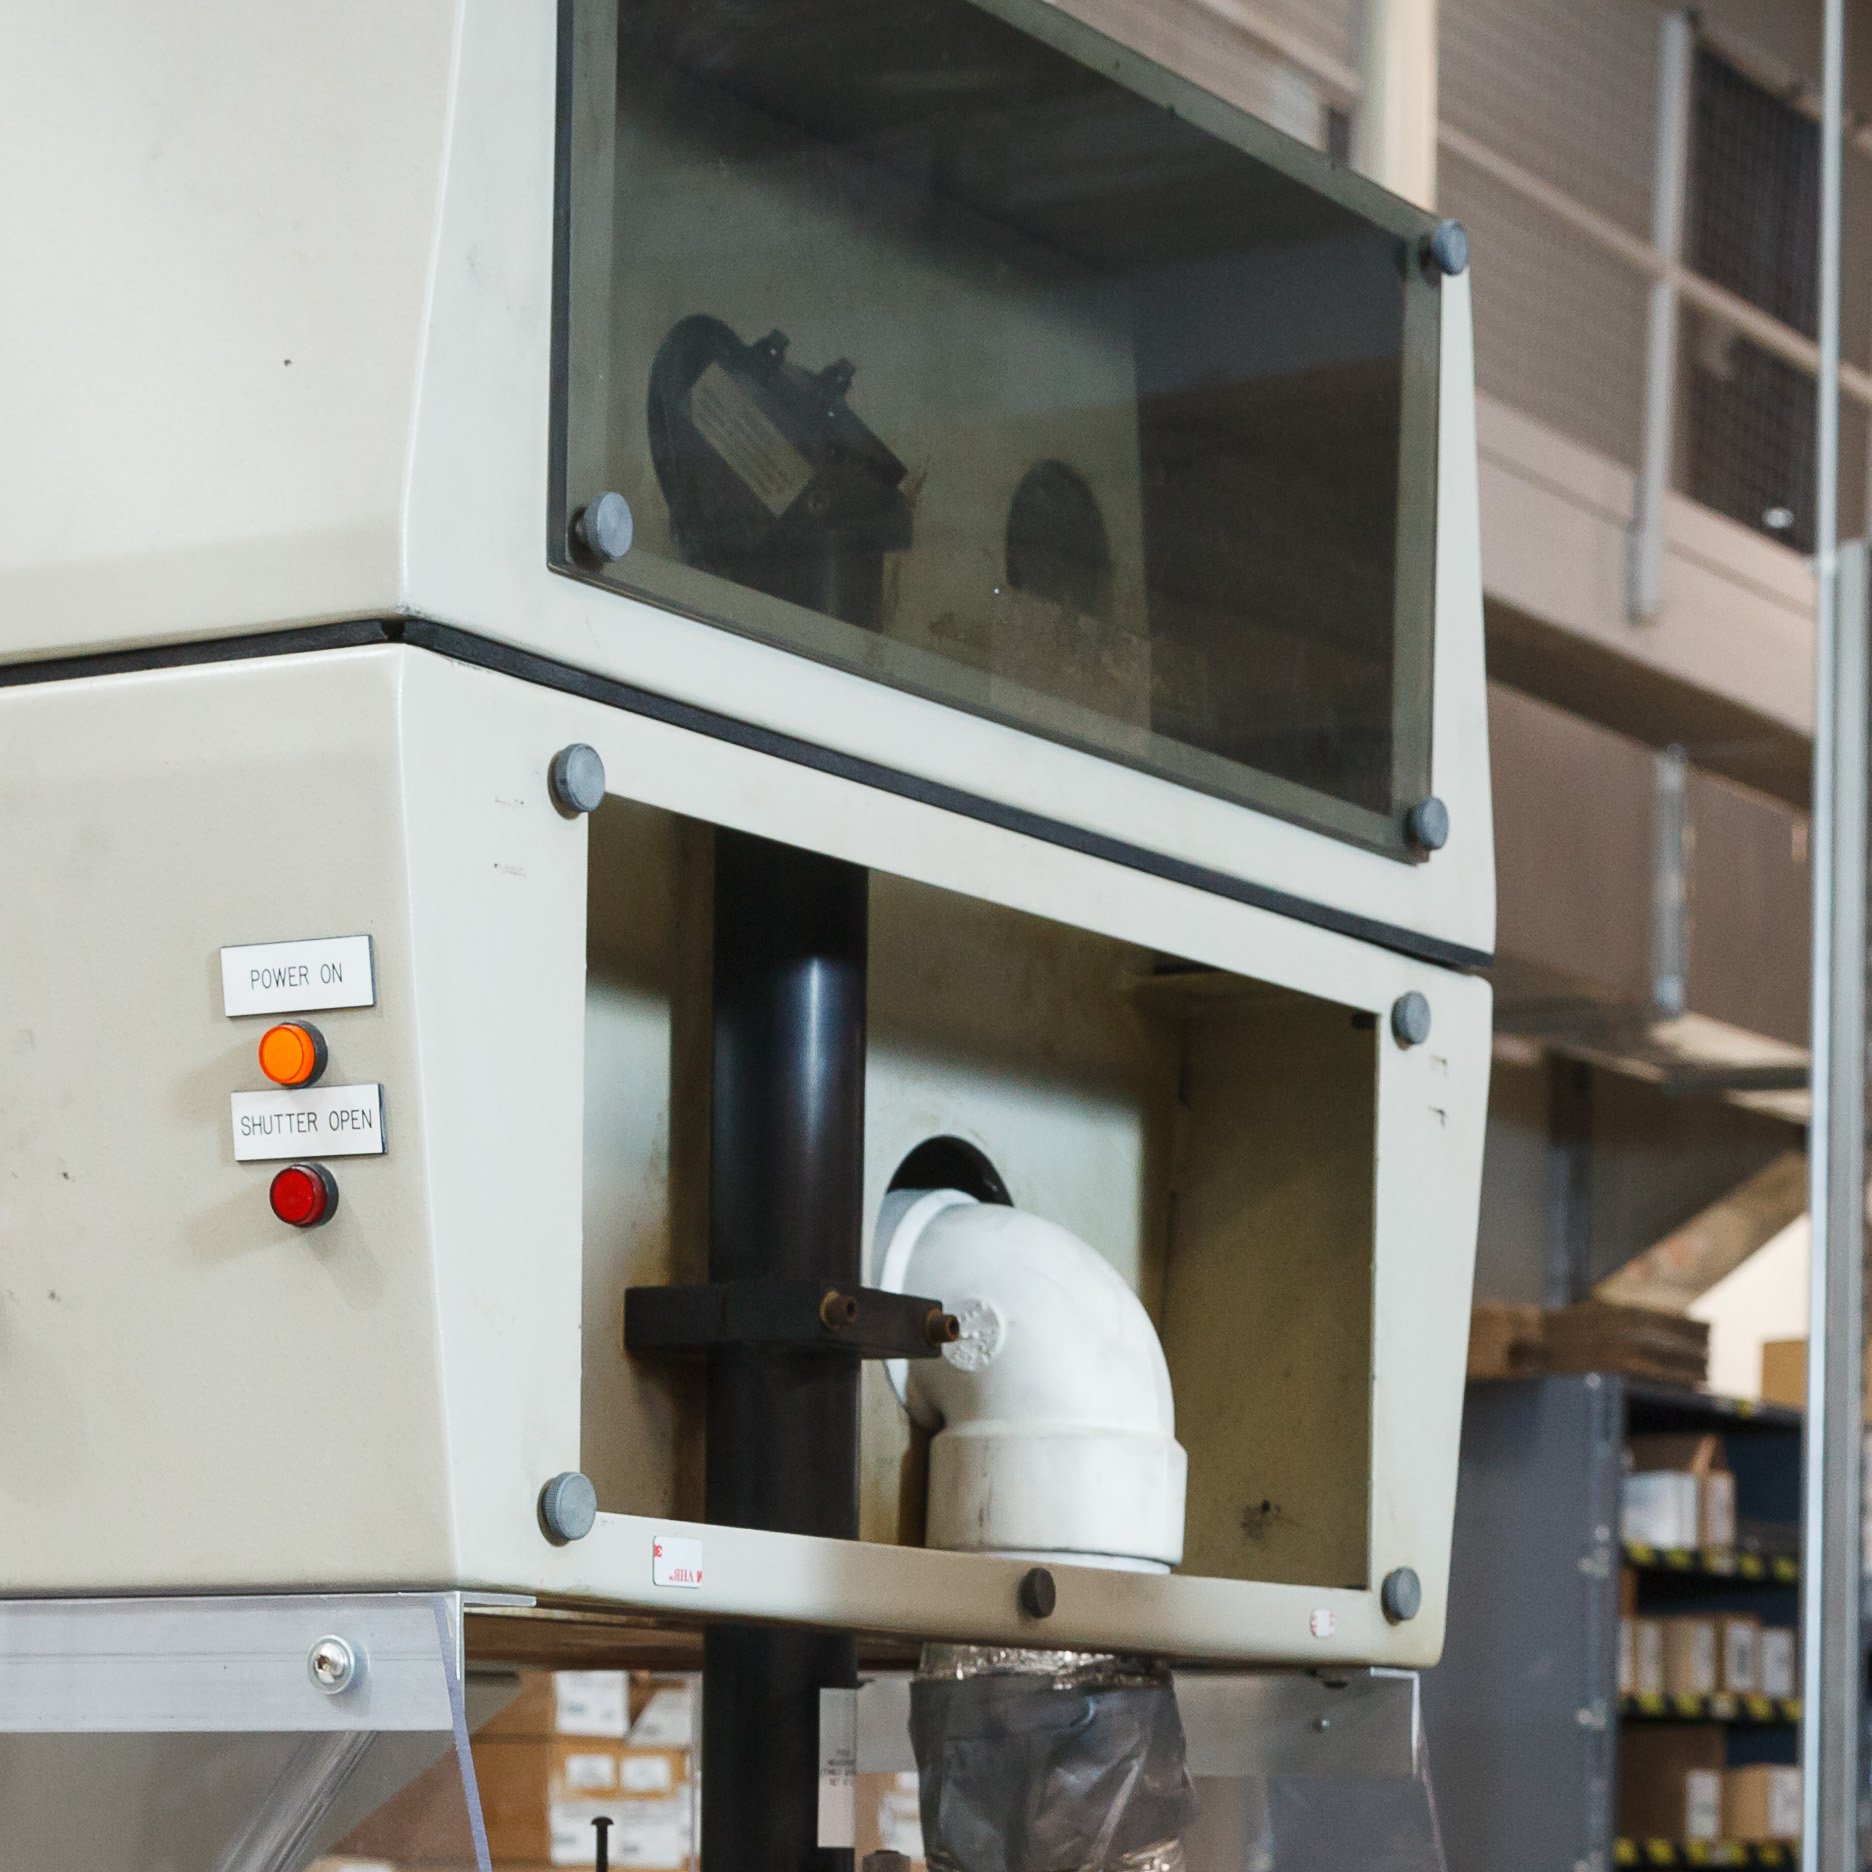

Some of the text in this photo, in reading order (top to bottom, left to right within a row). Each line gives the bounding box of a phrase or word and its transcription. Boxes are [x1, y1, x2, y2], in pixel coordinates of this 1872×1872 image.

[250, 963, 343, 989] POWER ON
[241, 1109, 372, 1136] SHUTTER OPEN
